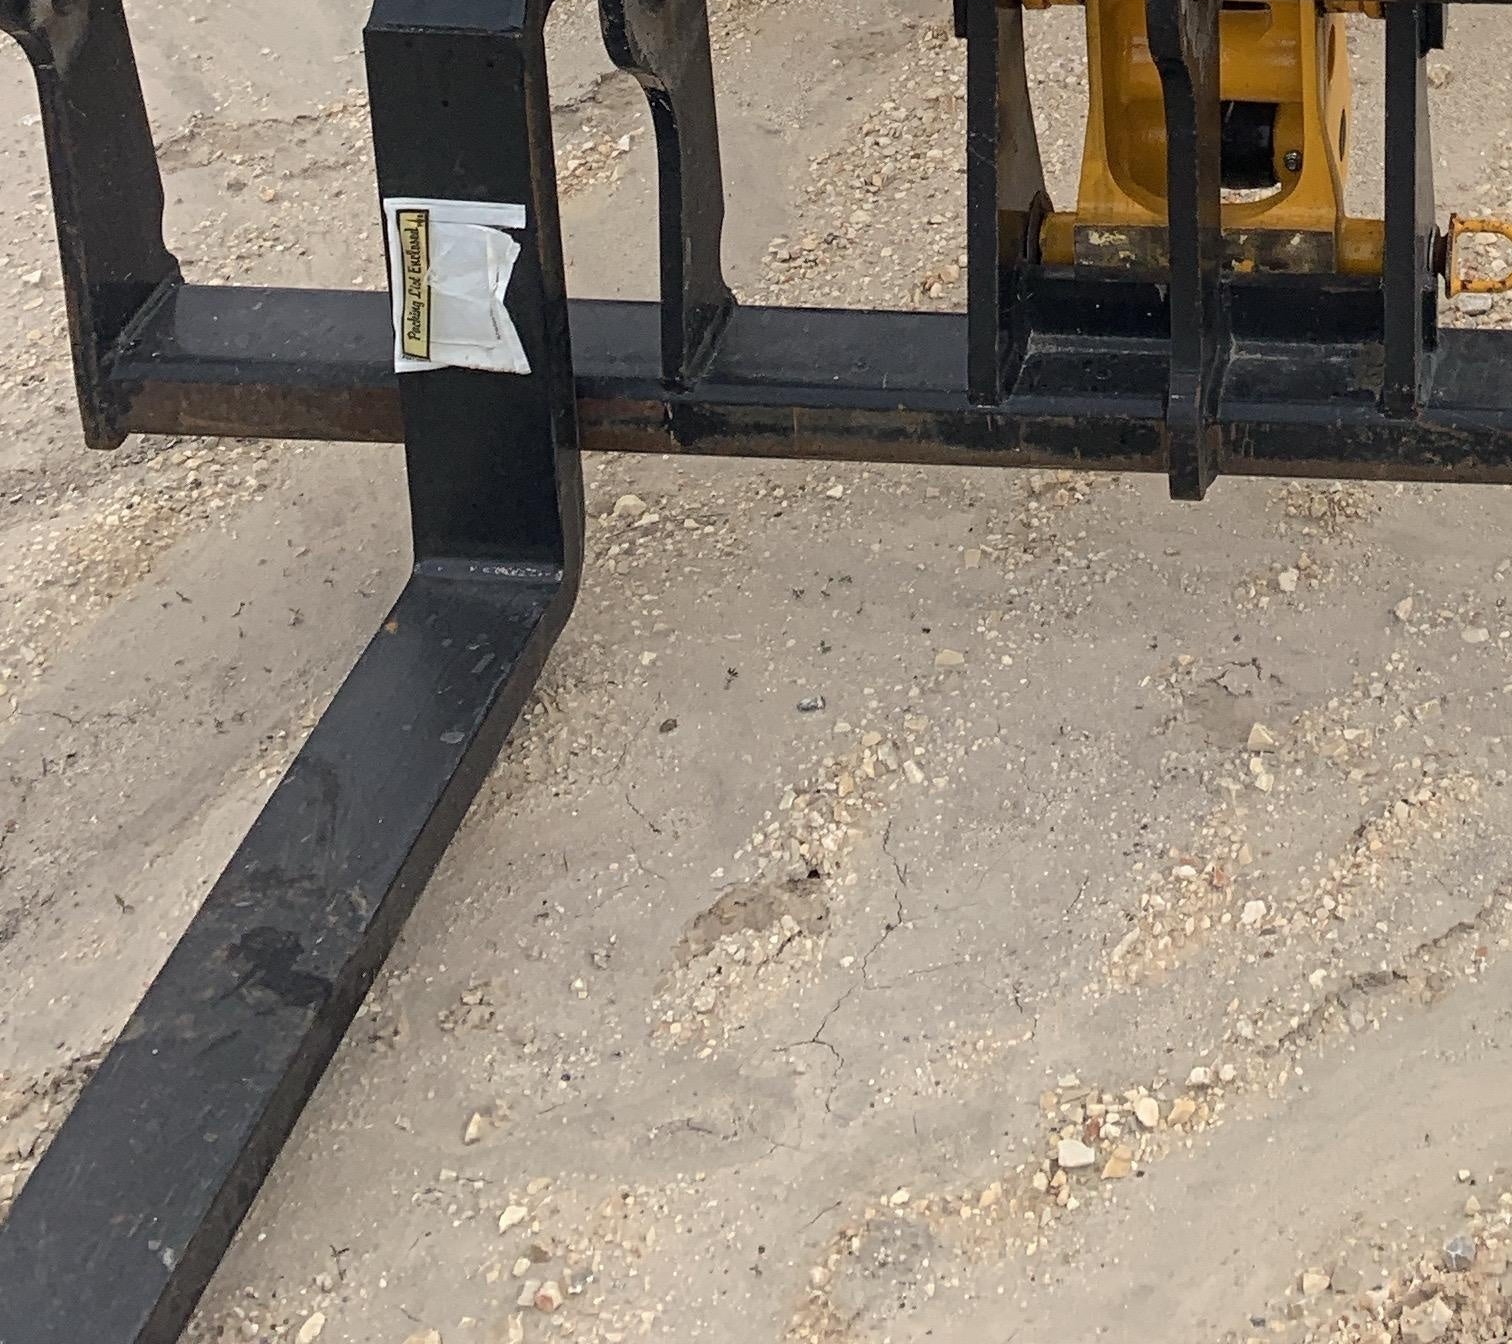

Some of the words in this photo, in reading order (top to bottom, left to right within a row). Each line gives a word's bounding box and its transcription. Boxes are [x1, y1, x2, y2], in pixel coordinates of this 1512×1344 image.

[403, 227, 422, 275] Enclosed
[407, 277, 423, 300] List
[406, 300, 426, 342] Packing
